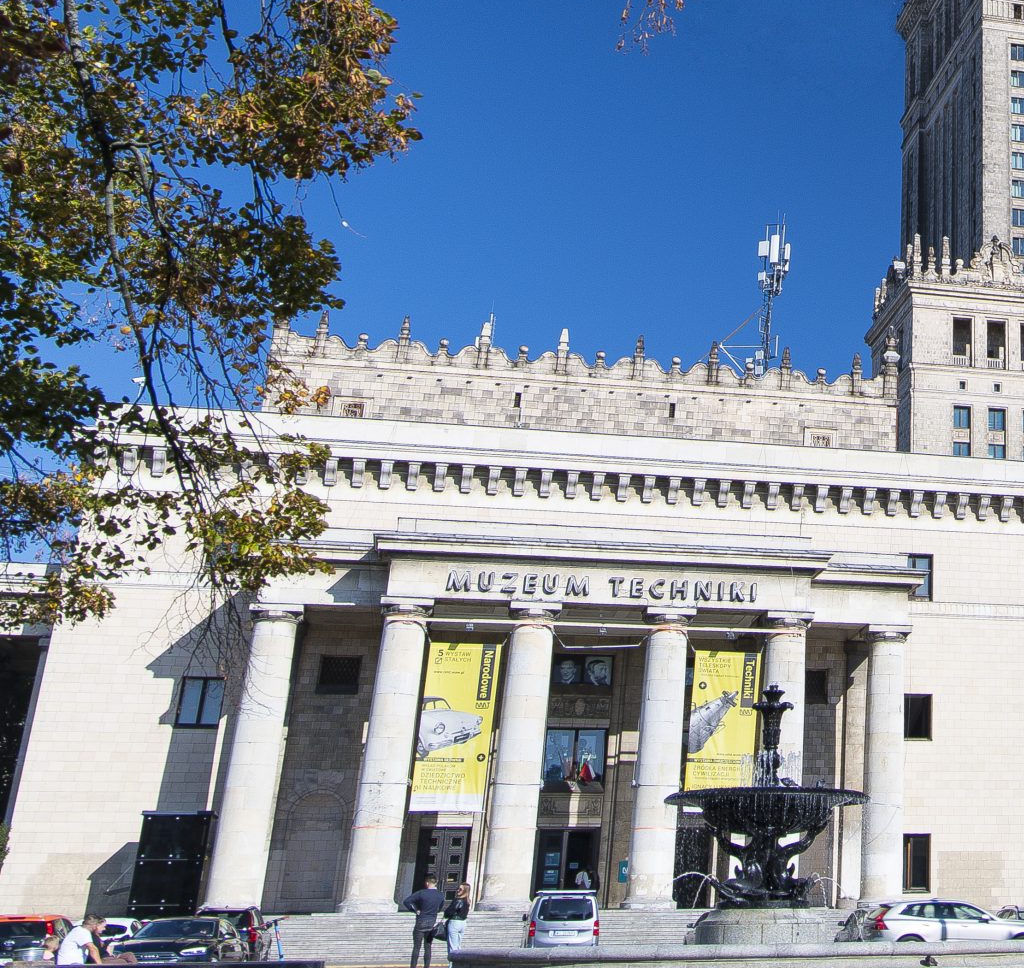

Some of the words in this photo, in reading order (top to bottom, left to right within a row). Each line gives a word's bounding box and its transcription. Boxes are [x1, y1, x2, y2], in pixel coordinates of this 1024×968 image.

[445, 569, 590, 596] MUZEUM
[608, 575, 758, 603] TECHNIKI
[438, 649, 444, 657] 5
[479, 650, 495, 699] Narodowe
[743, 660, 755, 699] Techniki
